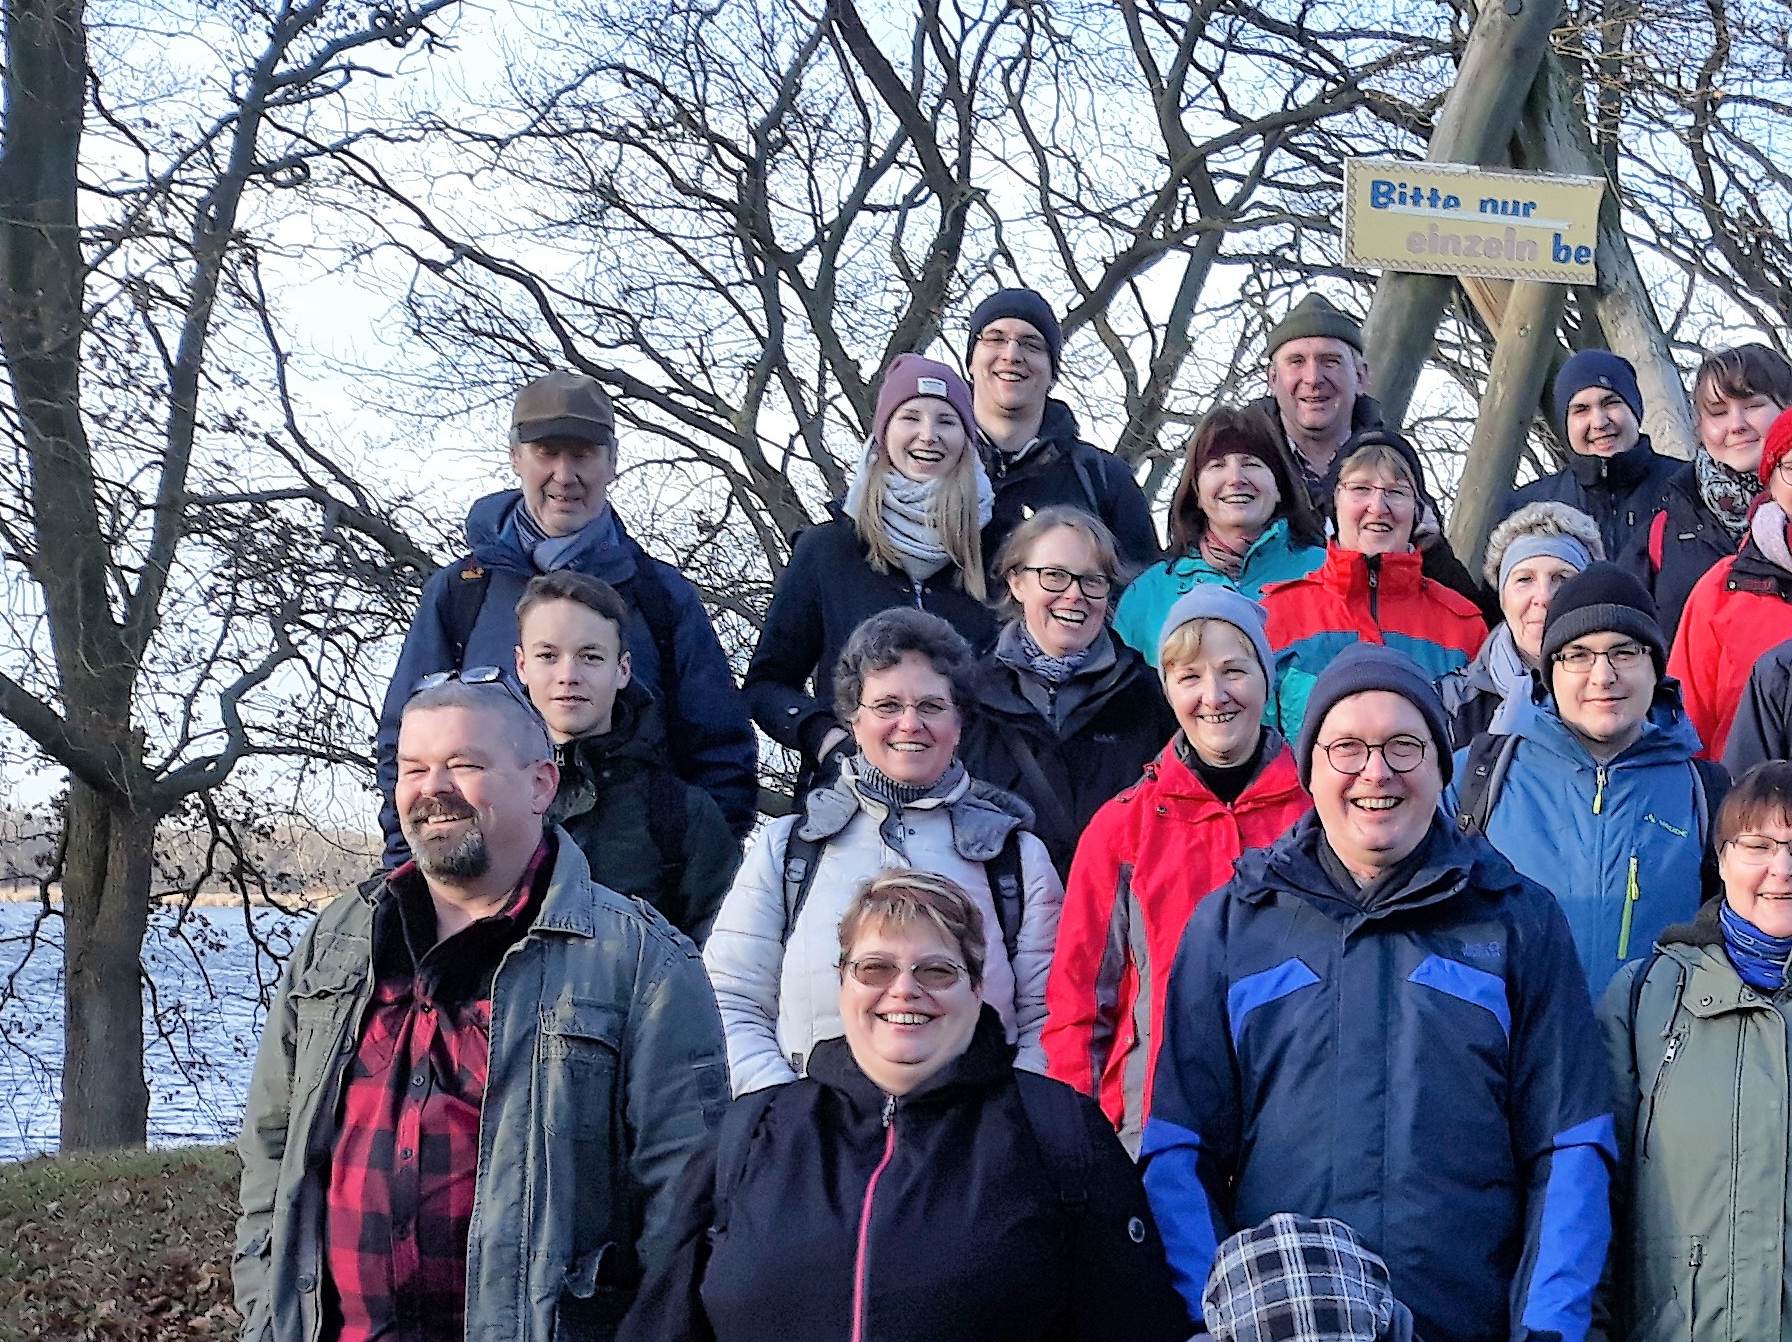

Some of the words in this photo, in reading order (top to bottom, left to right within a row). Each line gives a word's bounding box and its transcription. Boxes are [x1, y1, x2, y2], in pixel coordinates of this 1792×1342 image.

[1370, 179, 1461, 210] Bitte
[1479, 196, 1537, 218] nur
[1406, 223, 1539, 262] einzeln
